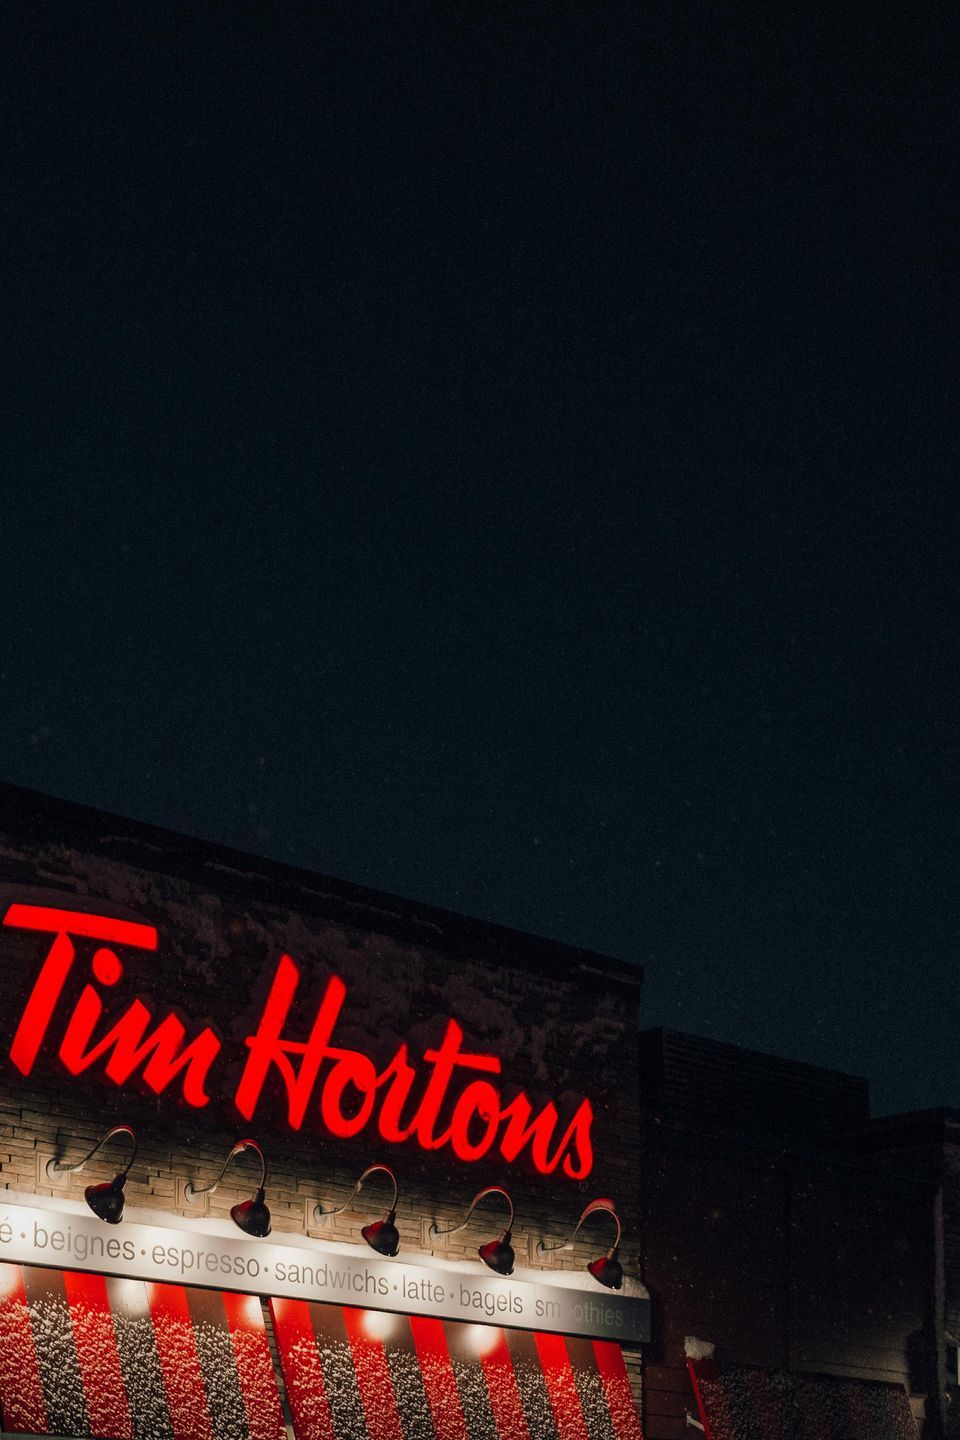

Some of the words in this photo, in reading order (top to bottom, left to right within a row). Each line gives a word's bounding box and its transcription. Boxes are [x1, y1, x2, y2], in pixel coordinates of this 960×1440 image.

[3, 903, 222, 1108] Tim
[235, 953, 594, 1180] Hortons
[33, 1220, 136, 1261] beignes
[152, 1244, 260, 1278] espresso
[275, 1261, 389, 1296] sandwichs
[402, 1274, 445, 1303] latte
[460, 1283, 523, 1316] bagels
